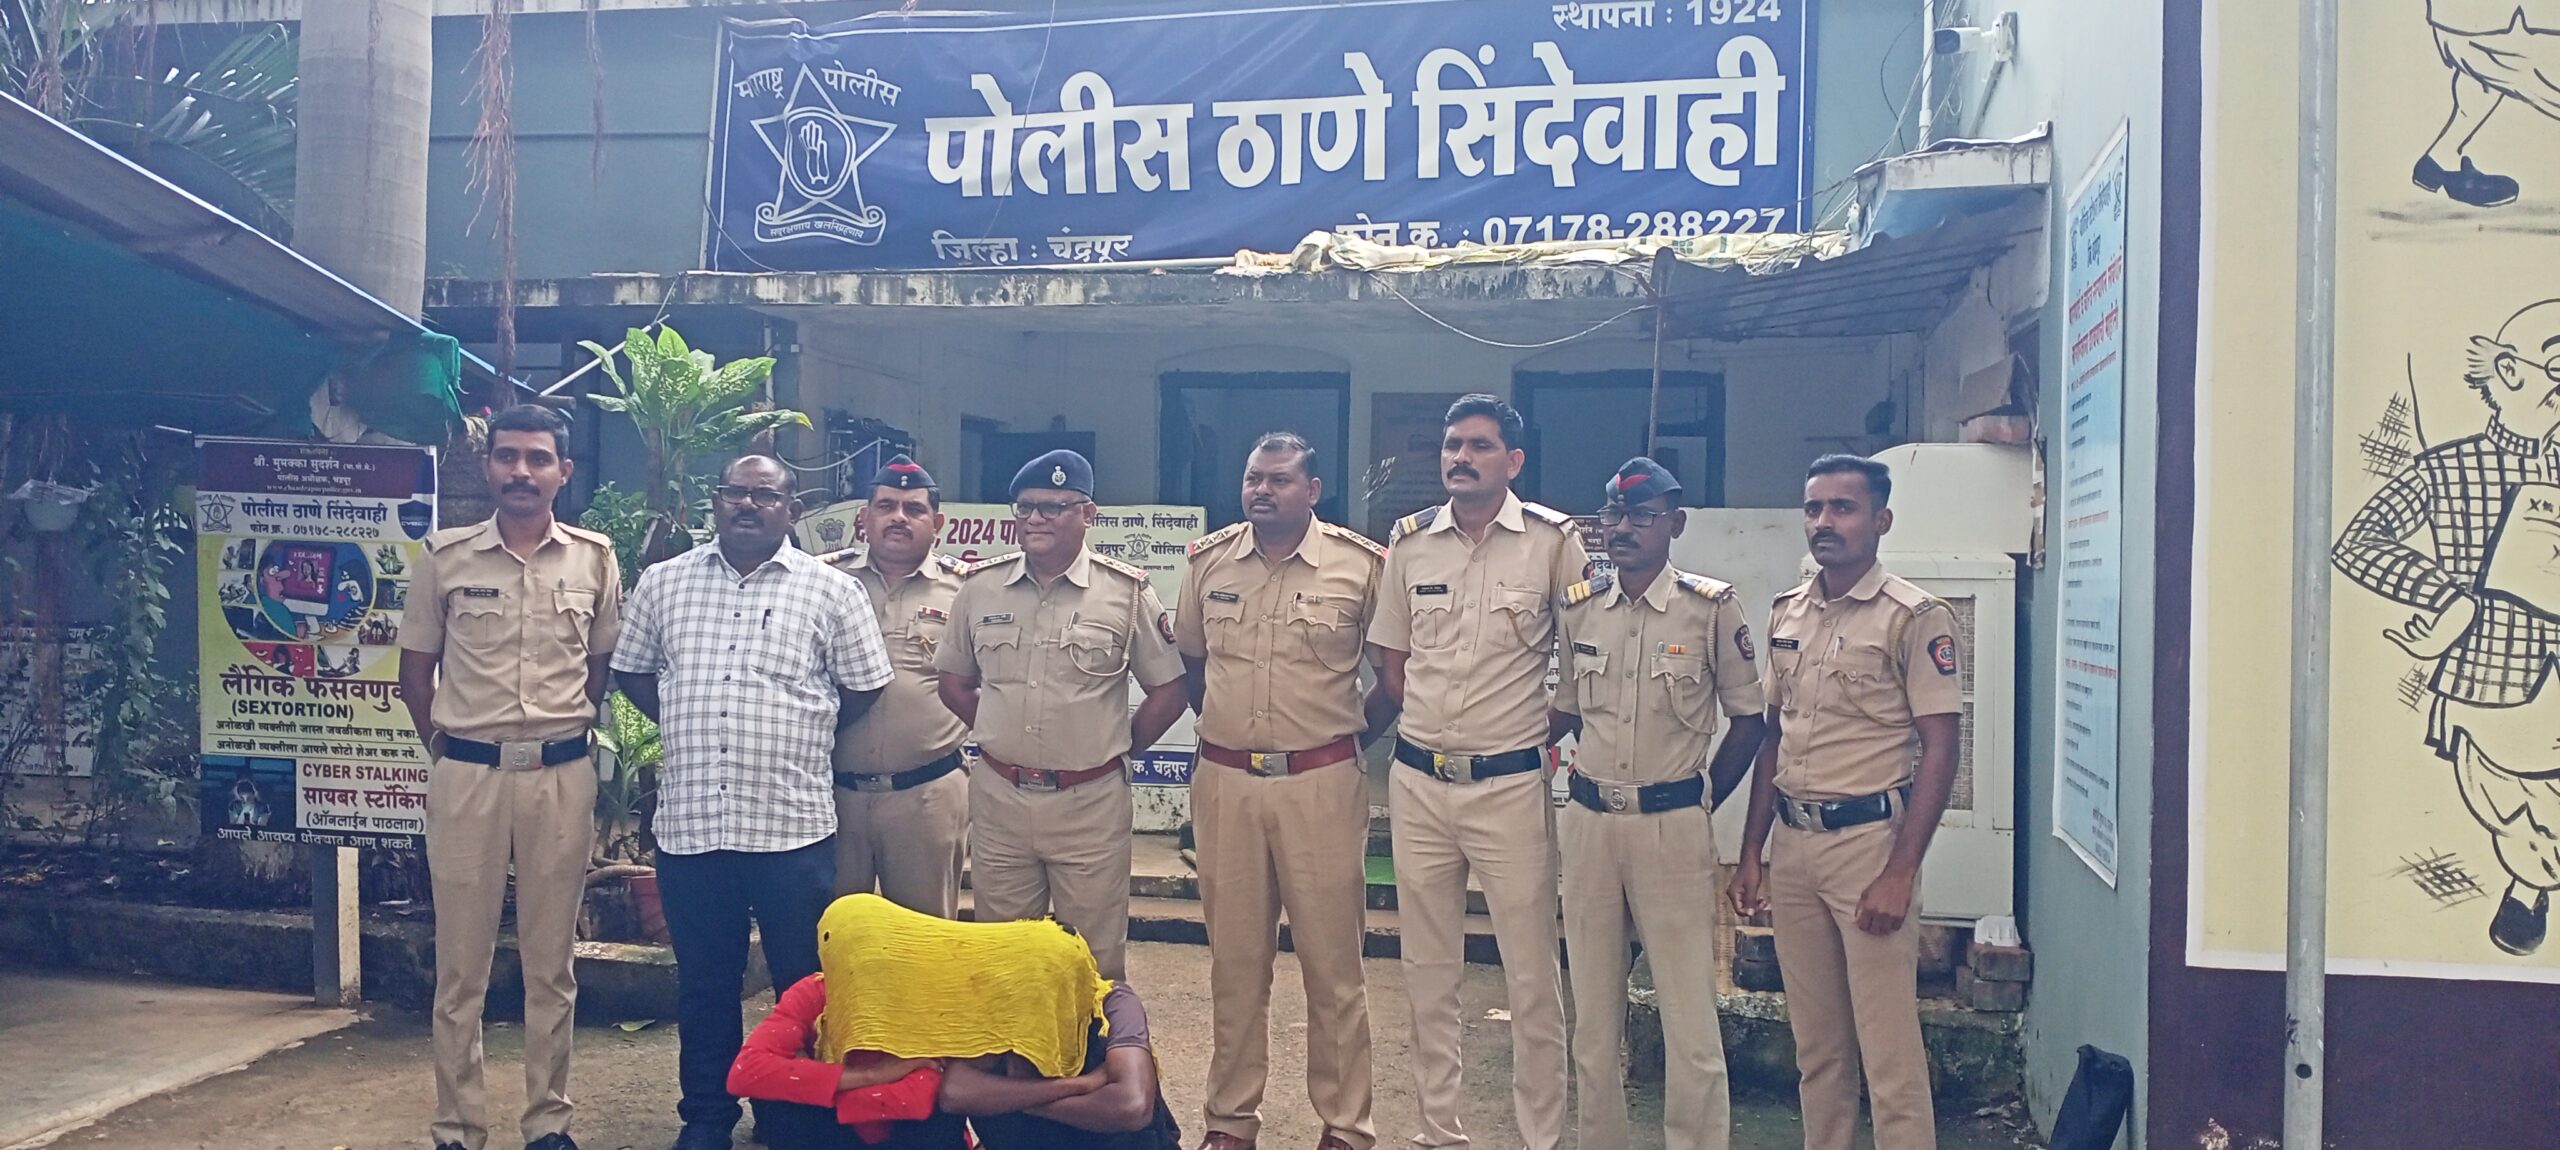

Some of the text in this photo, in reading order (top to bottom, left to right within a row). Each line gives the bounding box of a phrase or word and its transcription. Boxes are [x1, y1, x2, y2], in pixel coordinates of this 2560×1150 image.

[1552, 1, 1655, 31] स्थापना
[1686, 0, 1781, 26] 1924
[821, 60, 901, 107] पोलीस
[924, 35, 1786, 198] पोलीस ठाणे सिंदेवाही
[1483, 208, 1785, 246] 07178-288227
[931, 229, 1018, 266] जिल्हा
[1047, 226, 1133, 264] चंद्रपूर
[241, 497, 288, 517] पोलीस
[292, 499, 322, 519] ठाणे
[326, 500, 388, 525] सिंदेवाही
[1122, 513, 1148, 529] ठाणे,
[1151, 513, 1198, 531] सिंदेवाही
[250, 520, 269, 533] फोन
[946, 518, 995, 545] 2024
[1151, 541, 1186, 555] पोलिस
[219, 664, 296, 697] लैंगिक
[232, 699, 354, 722] (SEXTORTION)
[216, 717, 255, 731] अनोळखी
[299, 724, 322, 735] जास्त
[216, 737, 256, 750] अनोळखी
[301, 742, 328, 754] आपले
[331, 743, 353, 756] फोटो
[303, 763, 428, 783] CYBER STALKING
[1152, 756, 1188, 782] चंद्रपूर
[302, 784, 427, 810] सायबर स्टॉकिंग
[306, 810, 424, 833] (ऑनलाईन पाठलाग)
[217, 826, 252, 840] आपले
[381, 835, 417, 850] शकते.
